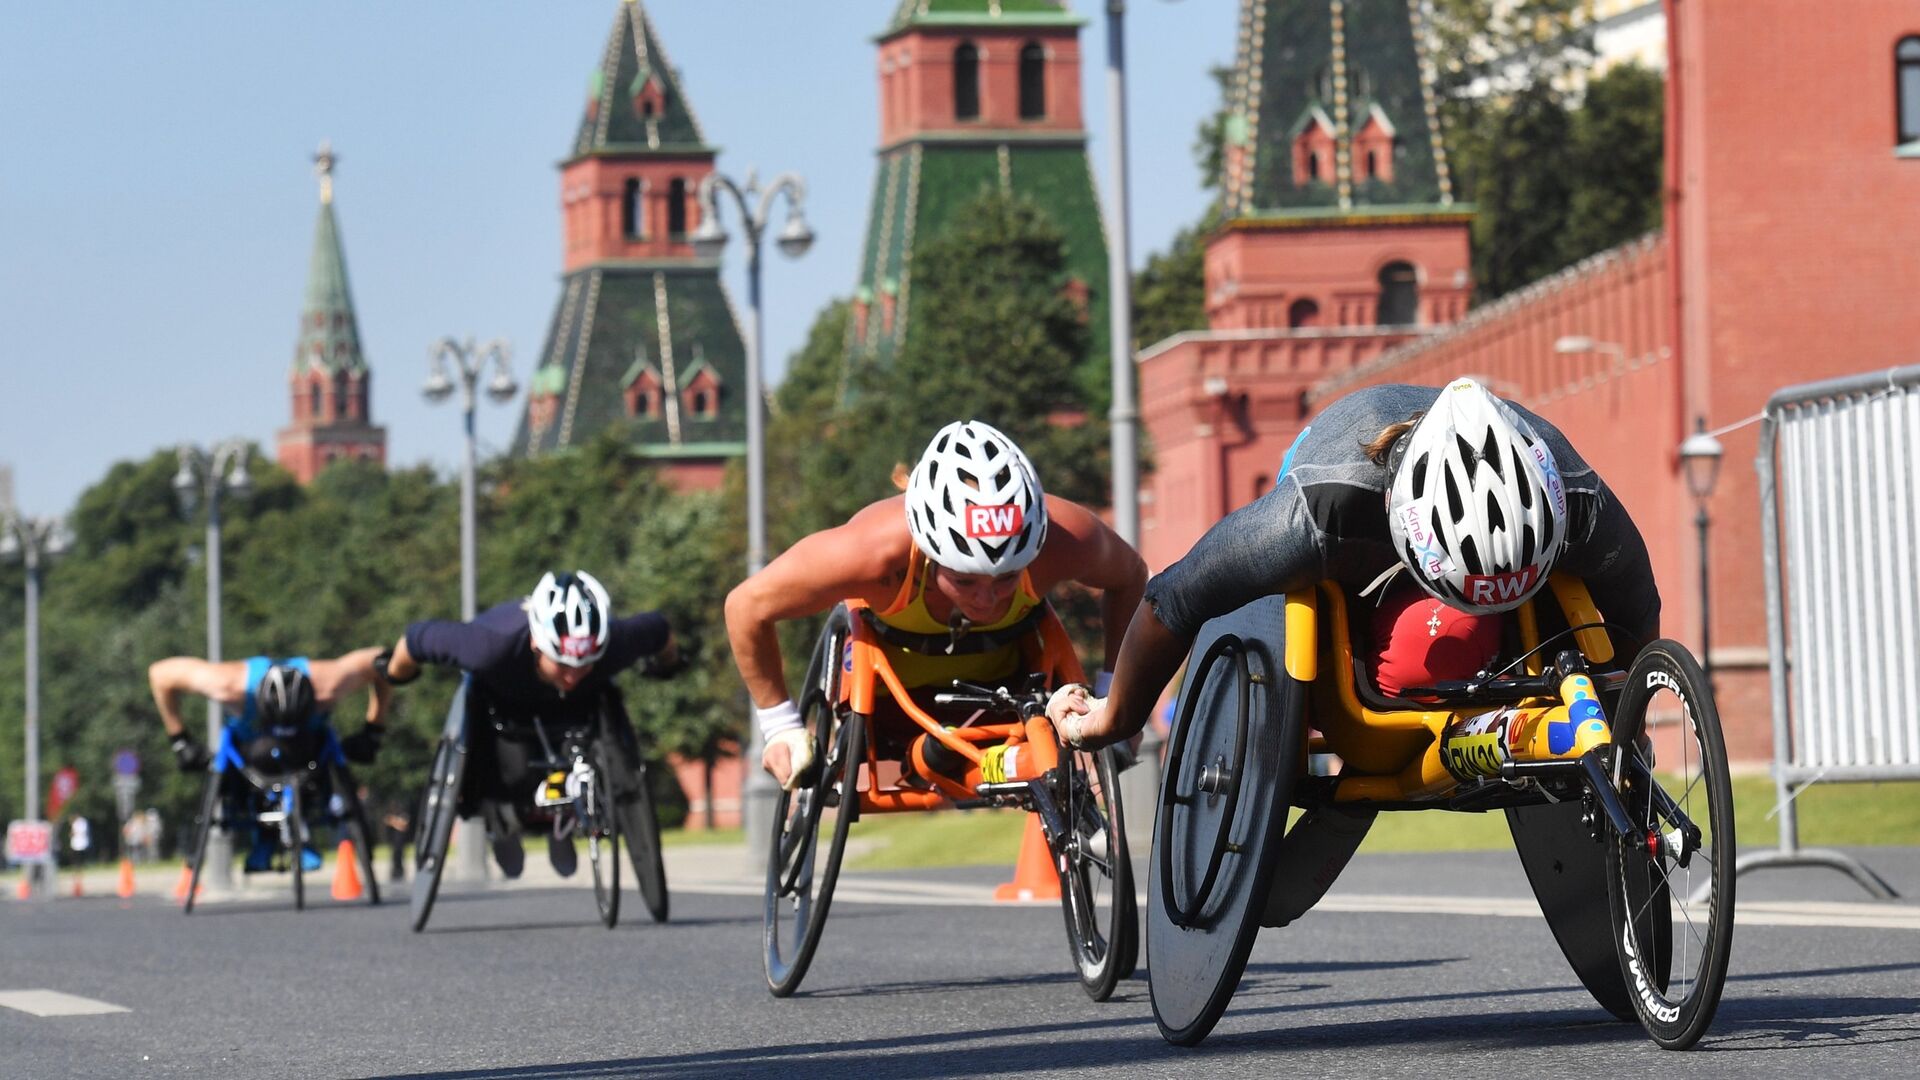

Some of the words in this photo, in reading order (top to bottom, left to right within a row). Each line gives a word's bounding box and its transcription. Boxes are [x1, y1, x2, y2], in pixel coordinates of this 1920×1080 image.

[971, 507, 1014, 534] RW
[1406, 506, 1442, 574] KineXib
[1473, 571, 1529, 602] RW
